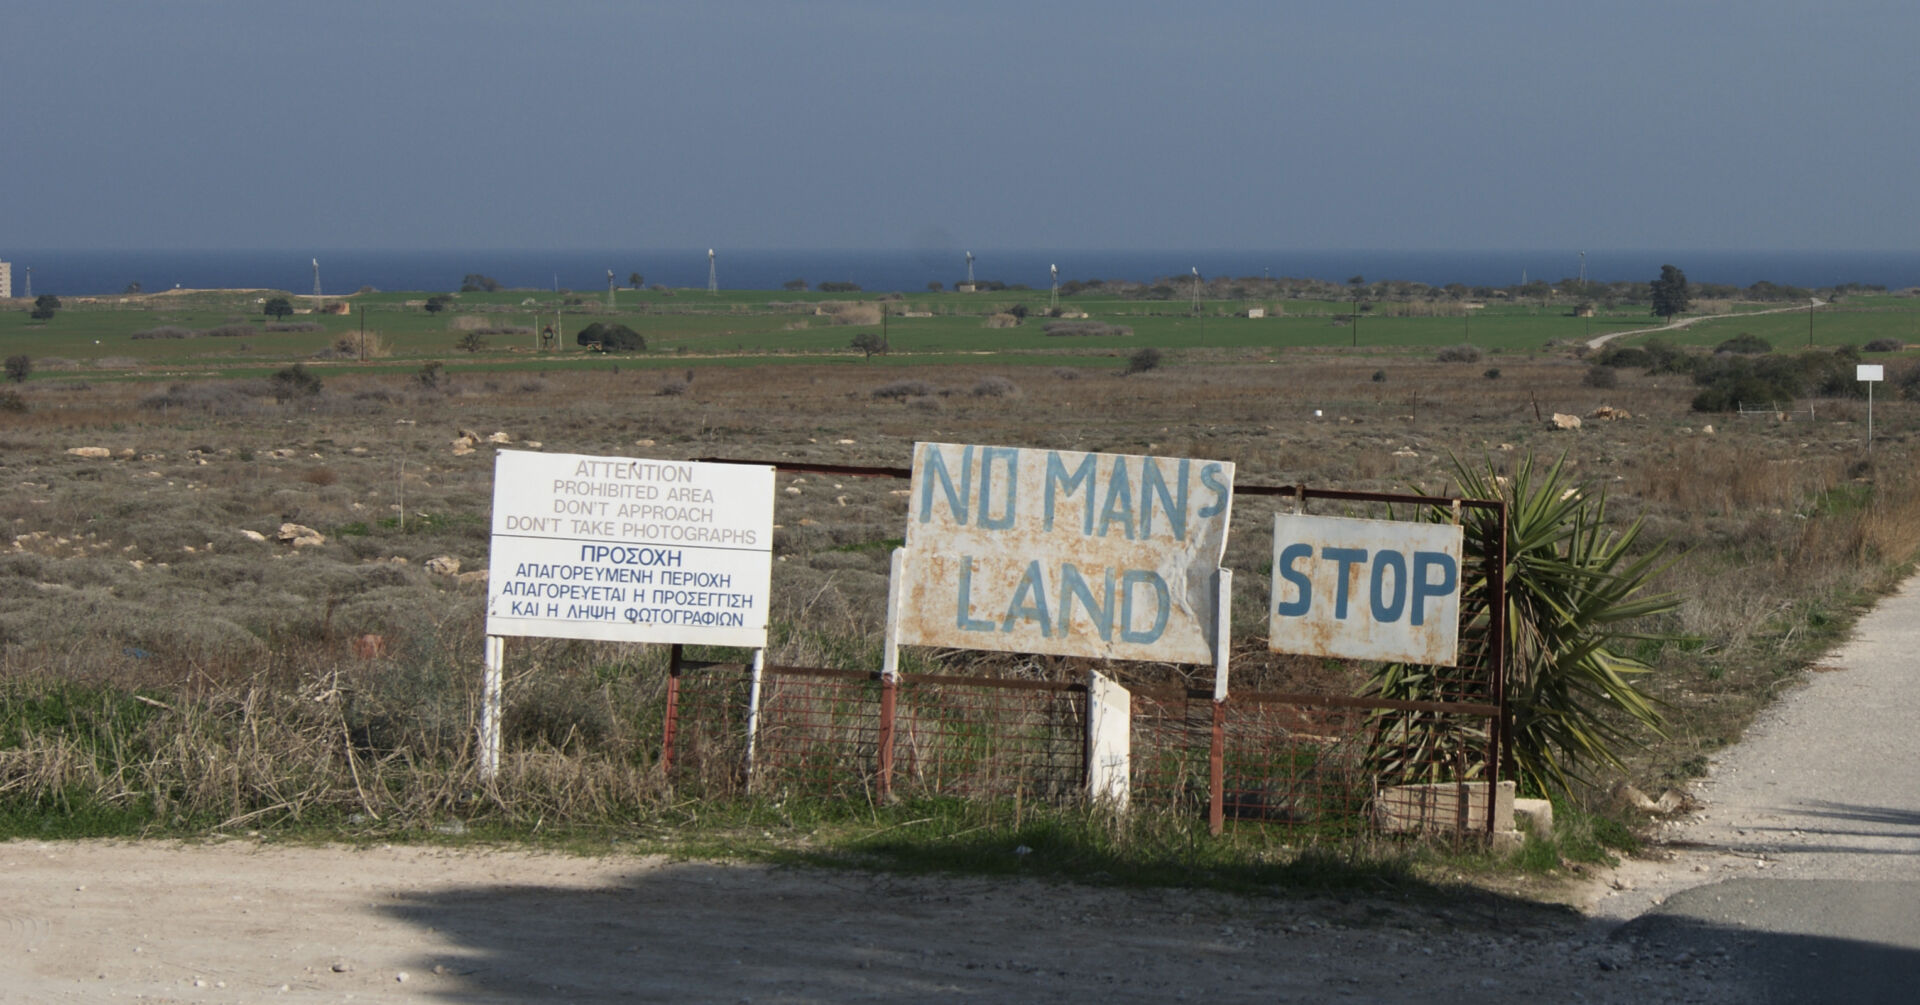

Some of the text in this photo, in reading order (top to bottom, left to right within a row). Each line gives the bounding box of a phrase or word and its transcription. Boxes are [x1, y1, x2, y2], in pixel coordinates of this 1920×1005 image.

[575, 460, 692, 482] ATTENTION
[553, 480, 714, 503] PROHIBITED AREA
[919, 443, 1019, 530] NO
[554, 500, 713, 522] DON'T APPROACH
[506, 516, 756, 545] DON'T TAKE PHOTOGRAPHS
[581, 545, 682, 567] ΠΡΟΣΟΧΗ
[516, 563, 730, 588] ΑΠΑΓΟΡΕΥΜΕΝΗ ΠΕΡΙΟΧΗ
[1278, 543, 1456, 625] STOP
[503, 582, 626, 601] ΑΠΑΓΟΡΕΥΕΤΑΙ
[653, 590, 753, 608] ΠΡΟΣΕΓΓΙΣΗ
[957, 556, 1170, 644] LAND
[511, 602, 539, 617] ΚΑΙ
[567, 605, 615, 620] ΛΗΨΗ
[625, 607, 743, 627] ΦΩΤΟΓΡΑΦΙΩΝ
